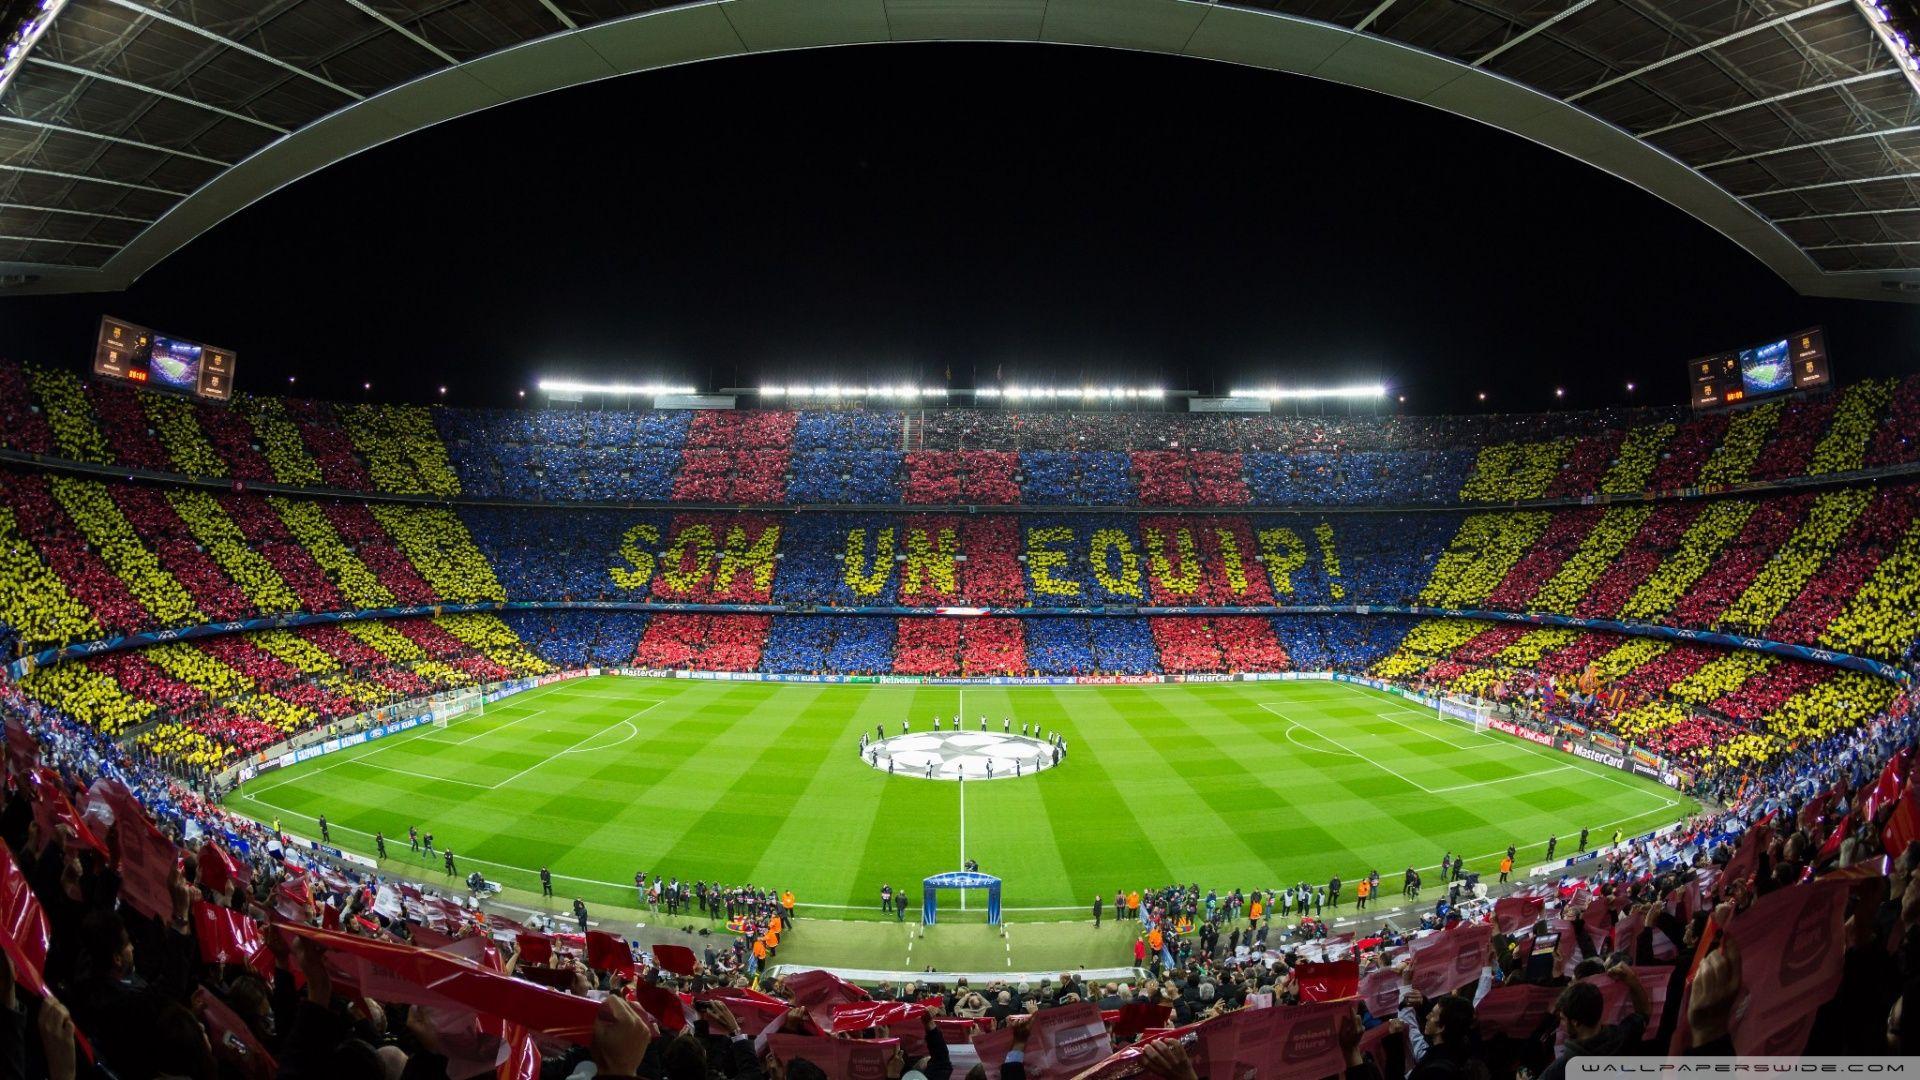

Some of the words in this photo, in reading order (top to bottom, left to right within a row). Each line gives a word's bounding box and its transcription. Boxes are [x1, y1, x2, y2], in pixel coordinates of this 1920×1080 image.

[609, 524, 780, 593] SOM
[844, 527, 960, 596] UN
[1026, 522, 1345, 599] EQUIP!
[621, 668, 667, 677] MasterCard
[880, 675, 921, 684] Heineken
[1008, 677, 1049, 685] PlayStation
[1186, 674, 1234, 683] MasterCard
[387, 724, 400, 733] NEW
[1523, 728, 1551, 745] UniCredit
[1574, 744, 1625, 770] MasterCard
